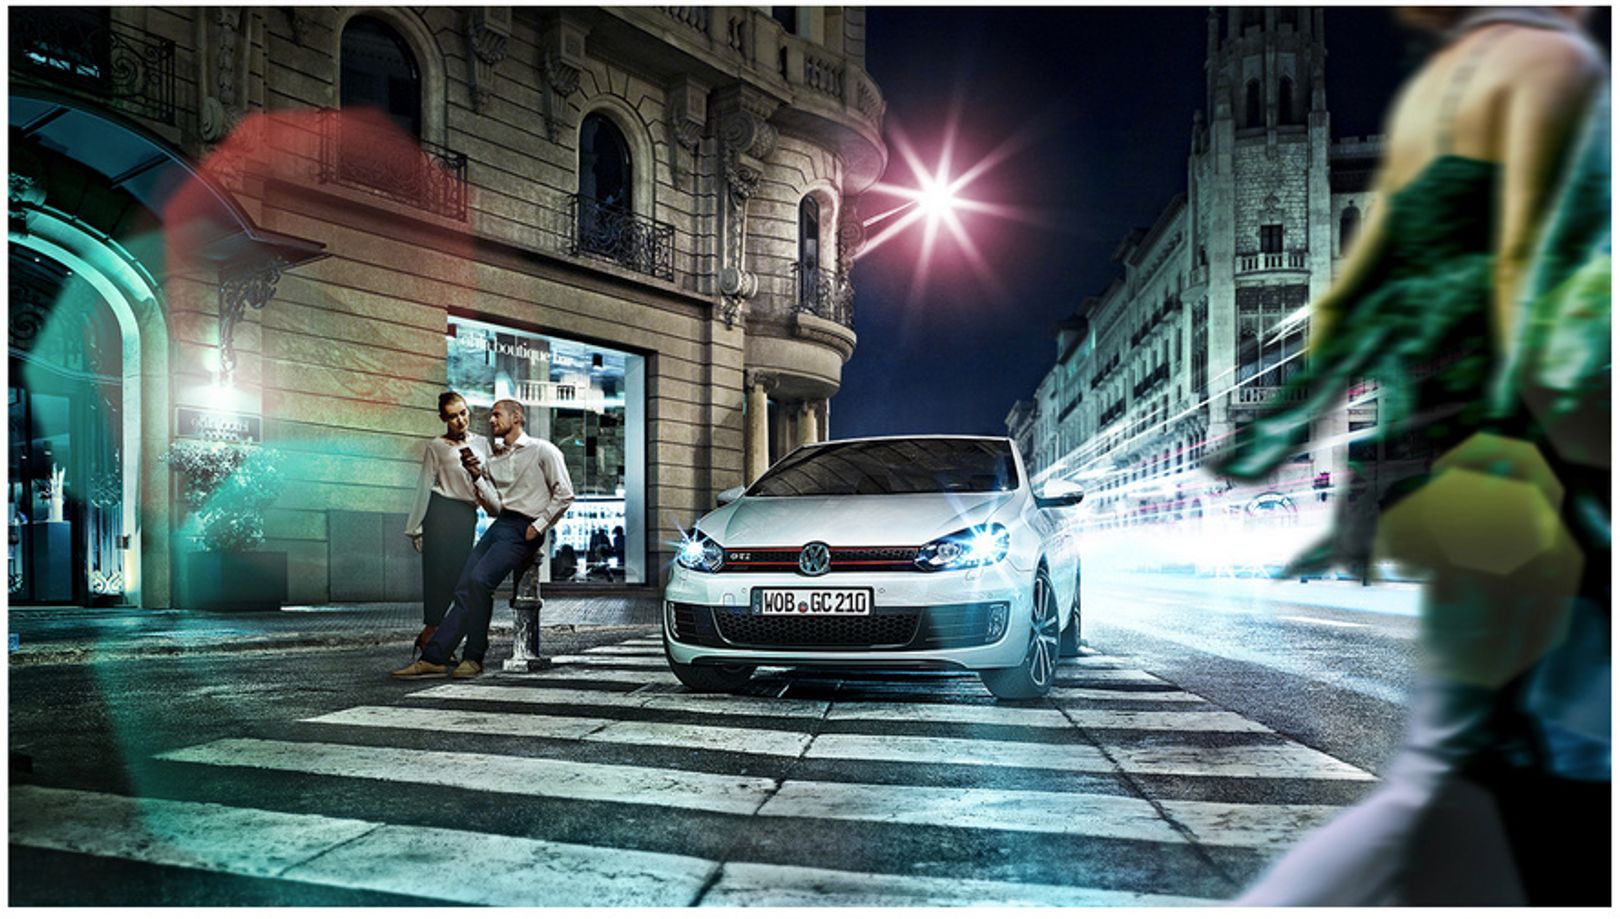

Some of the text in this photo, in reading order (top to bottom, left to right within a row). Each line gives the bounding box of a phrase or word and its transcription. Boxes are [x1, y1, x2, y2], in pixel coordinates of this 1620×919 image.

[494, 335, 550, 365] boutique
[764, 592, 866, 612] WOB GC 210
